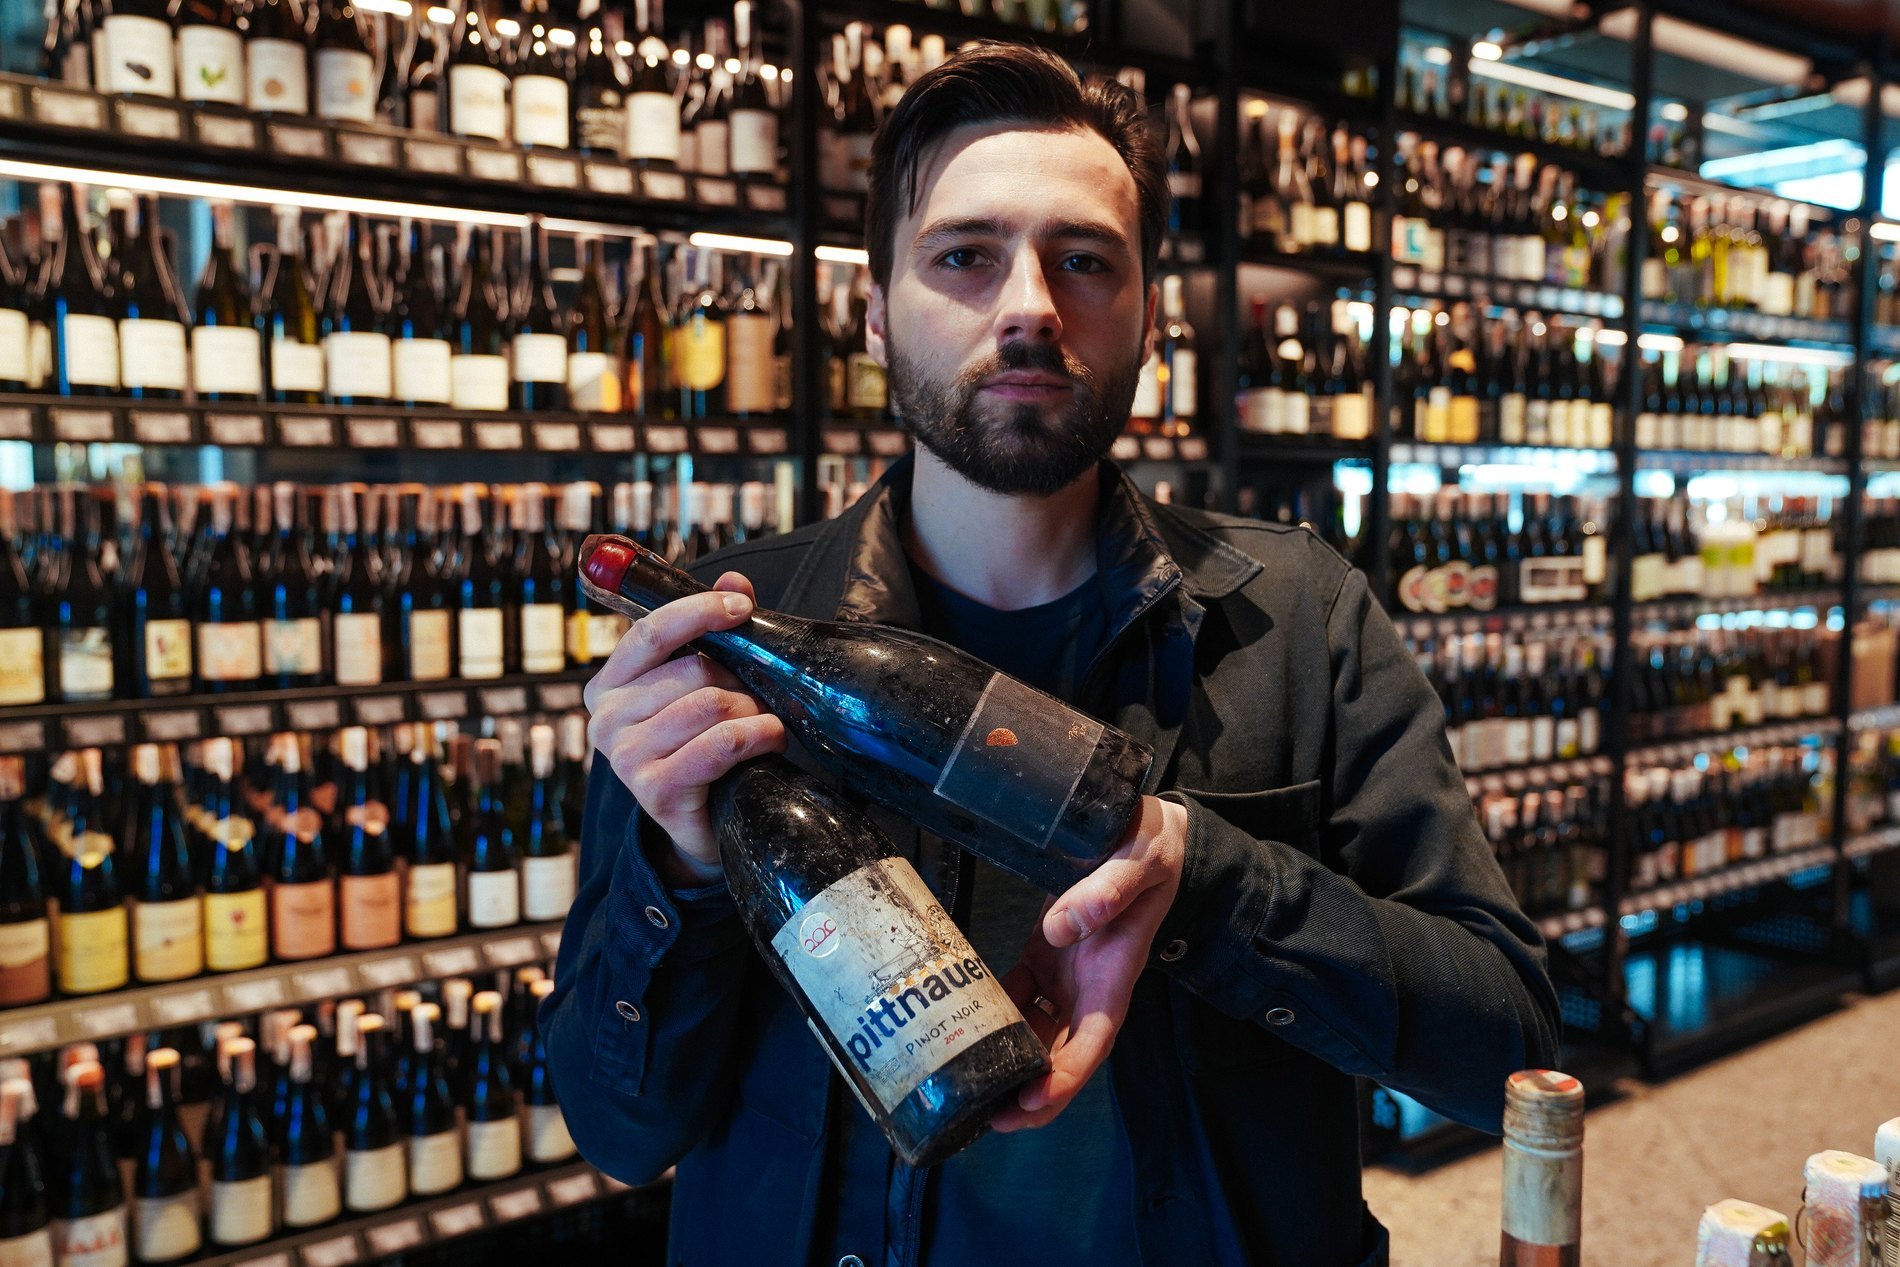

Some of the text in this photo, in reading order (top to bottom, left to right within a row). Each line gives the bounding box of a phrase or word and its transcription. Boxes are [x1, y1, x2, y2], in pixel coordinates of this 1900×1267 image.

[905, 1000, 984, 1056] PINOT NOIR
[943, 1027, 965, 1046] 2018
